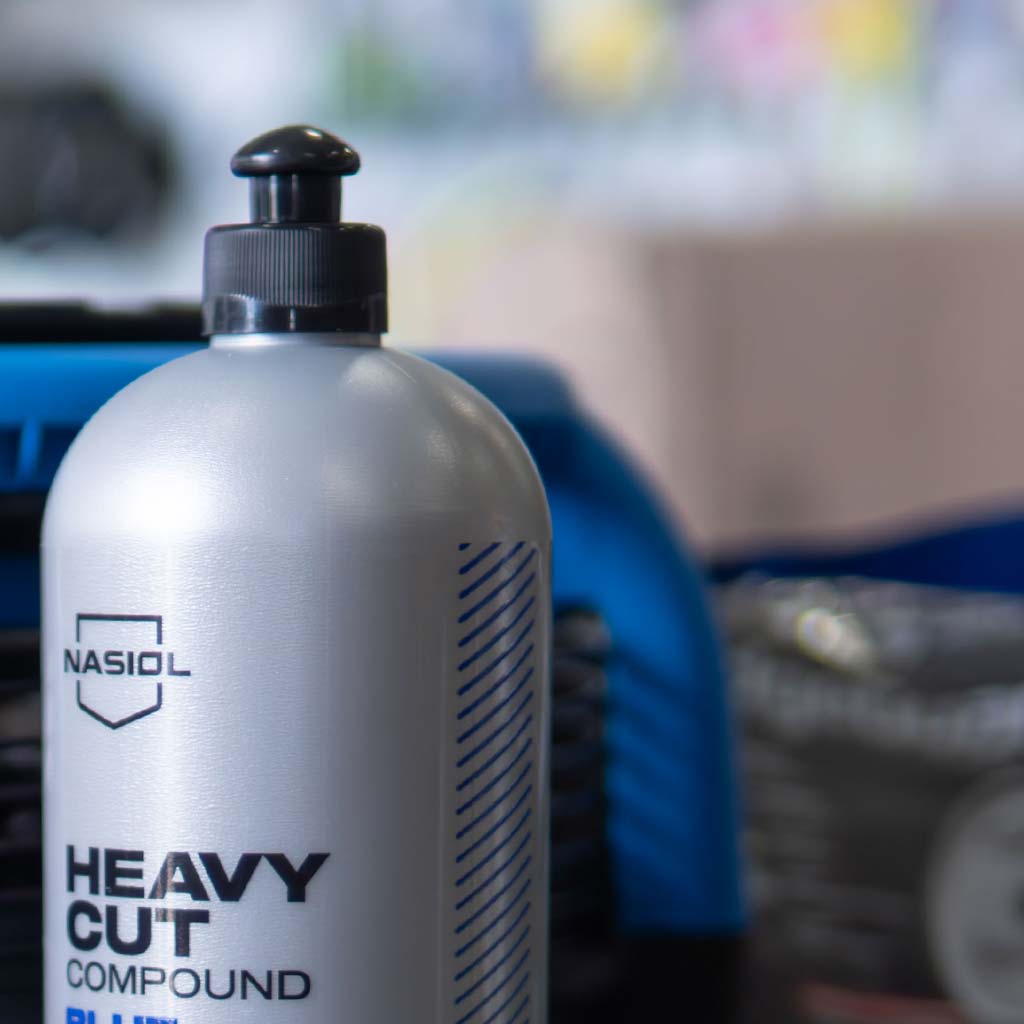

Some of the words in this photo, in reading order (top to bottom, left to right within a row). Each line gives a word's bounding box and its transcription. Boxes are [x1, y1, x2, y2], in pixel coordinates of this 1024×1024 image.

[64, 648, 191, 677] NASIOL
[66, 845, 330, 903] HEAVY
[66, 900, 210, 957] CUT
[66, 958, 311, 1000] COMPOUND
